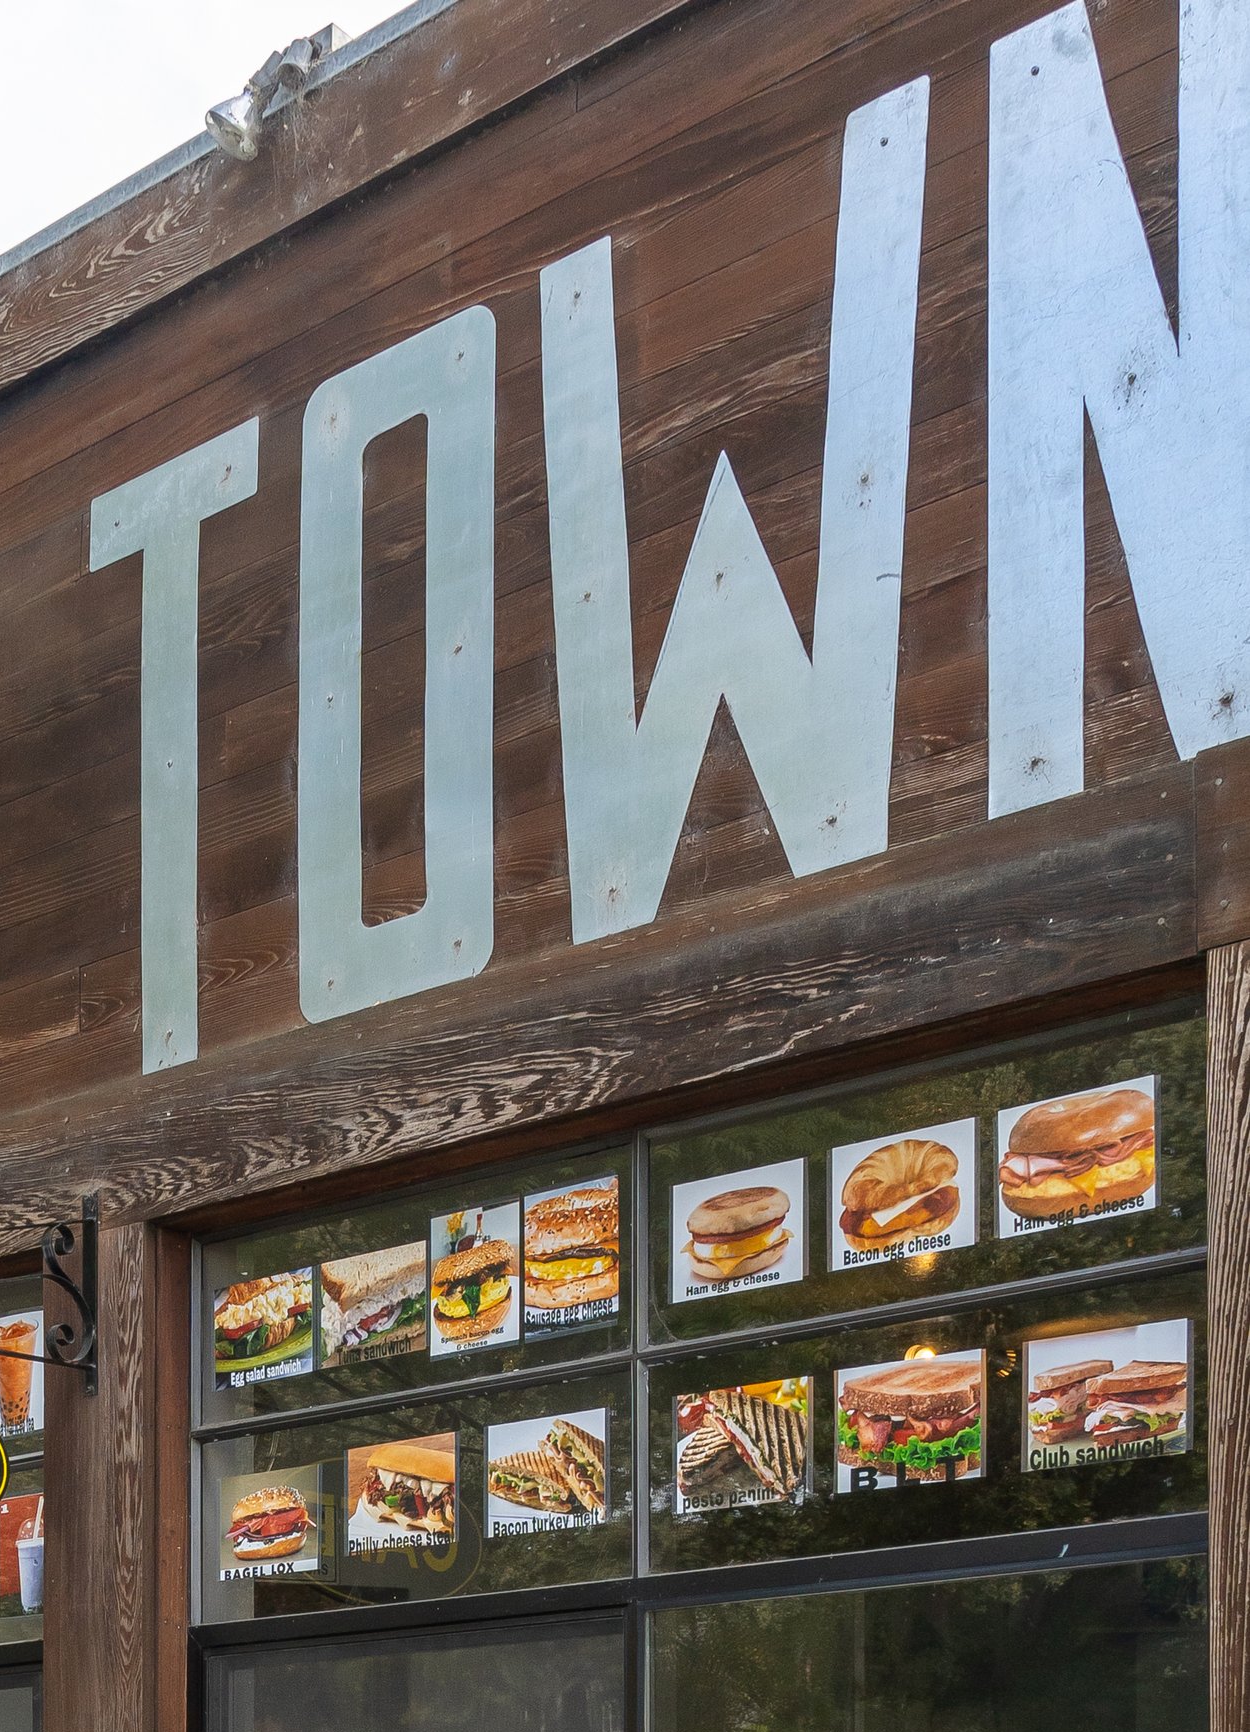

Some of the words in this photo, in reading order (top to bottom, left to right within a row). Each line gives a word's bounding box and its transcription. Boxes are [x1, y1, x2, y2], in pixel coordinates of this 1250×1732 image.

[90, 0, 1250, 1075] TOWN
[1013, 1216, 1044, 1233] Ham
[1050, 1206, 1075, 1227] egg
[1078, 1203, 1090, 1218] &
[1094, 1194, 1146, 1216] cheese
[843, 1247, 880, 1267] Bacon
[883, 1240, 905, 1260] egg
[907, 1233, 951, 1254] cheese
[685, 1283, 709, 1297] Ham
[711, 1278, 730, 1294] egg
[733, 1277, 741, 1288] &
[743, 1270, 780, 1287] cheese
[524, 1308, 562, 1326] Sausage
[563, 1305, 579, 1323] egg
[582, 1298, 613, 1320] cheese
[440, 1332, 468, 1344] Spinach
[469, 1328, 491, 1339] bacon
[491, 1325, 505, 1336] egg
[463, 1339, 489, 1349] cheese
[336, 1345, 361, 1366] Tuna
[364, 1338, 412, 1361] sandwich
[230, 1371, 245, 1388] Egg
[245, 1365, 265, 1383] salad
[266, 1359, 302, 1381] sandwich
[1030, 1445, 1070, 1470] Club
[1075, 1435, 1165, 1464] sandwich
[682, 1491, 723, 1512] pesto
[493, 1521, 530, 1538] Bacon
[532, 1513, 570, 1532] turkey
[574, 1507, 599, 1527] melt
[349, 1535, 379, 1556] Philly
[382, 1532, 422, 1551] cheese
[224, 1566, 267, 1582] BAGEL
[271, 1561, 296, 1575] LOX
